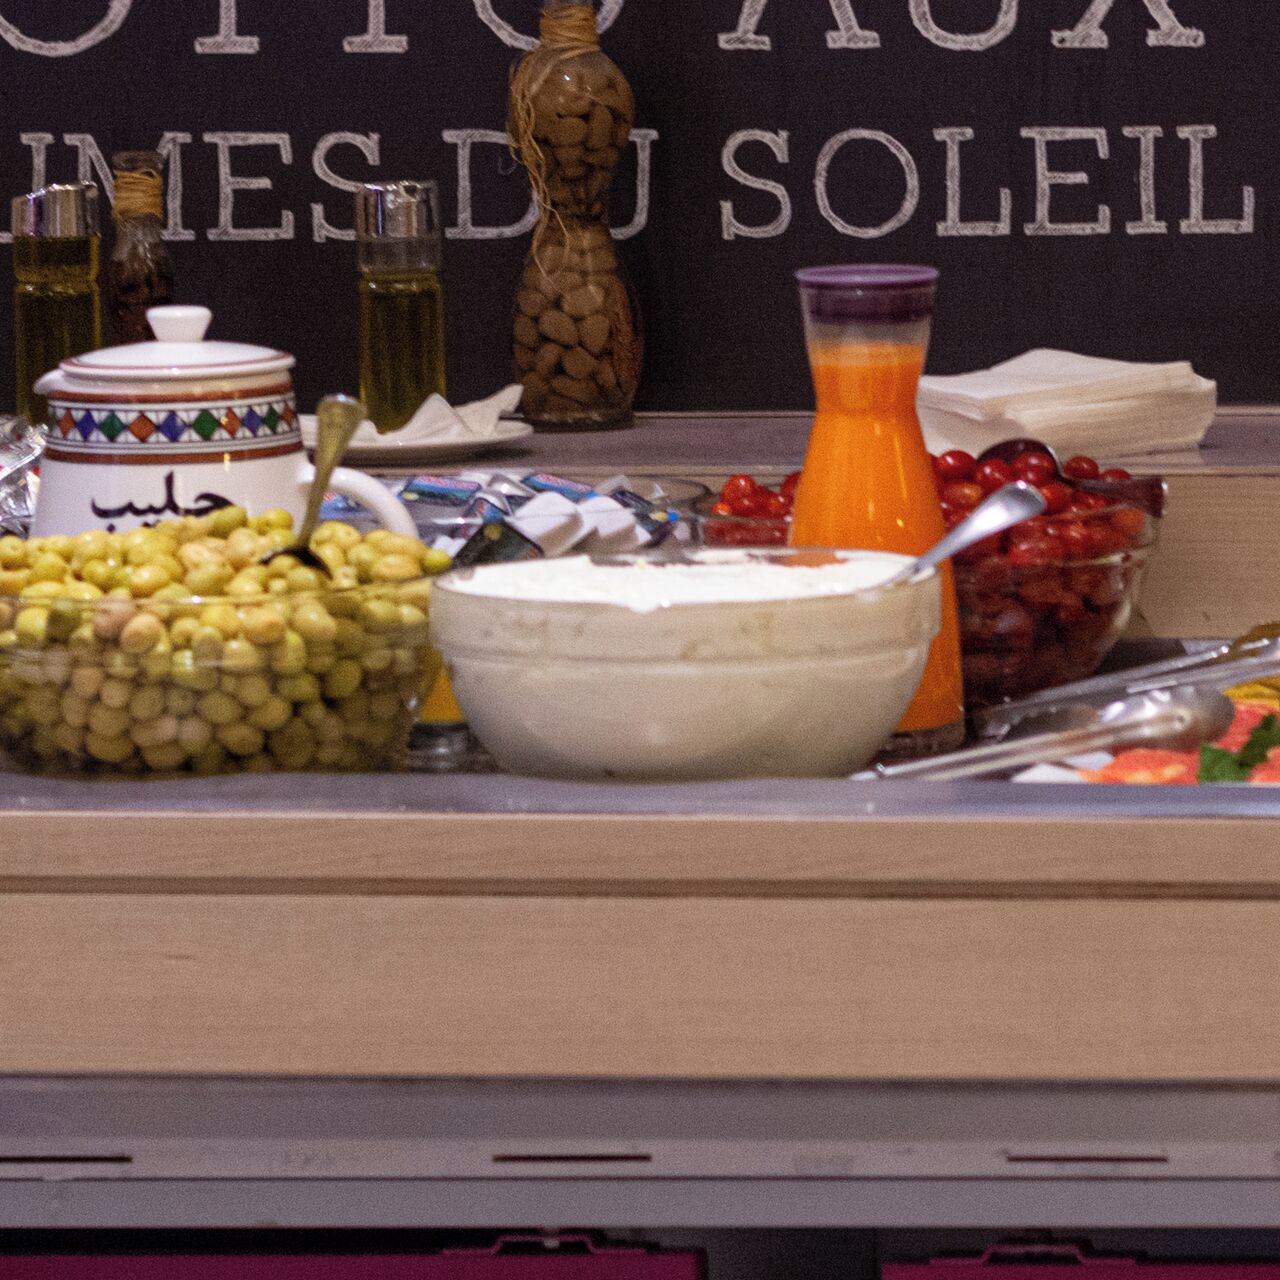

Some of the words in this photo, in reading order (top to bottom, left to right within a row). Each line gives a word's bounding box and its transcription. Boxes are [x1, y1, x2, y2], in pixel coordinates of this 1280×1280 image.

[441, 128, 660, 241] DU
[721, 125, 1254, 239] SOLEIL
[91, 471, 234, 534] حليب
